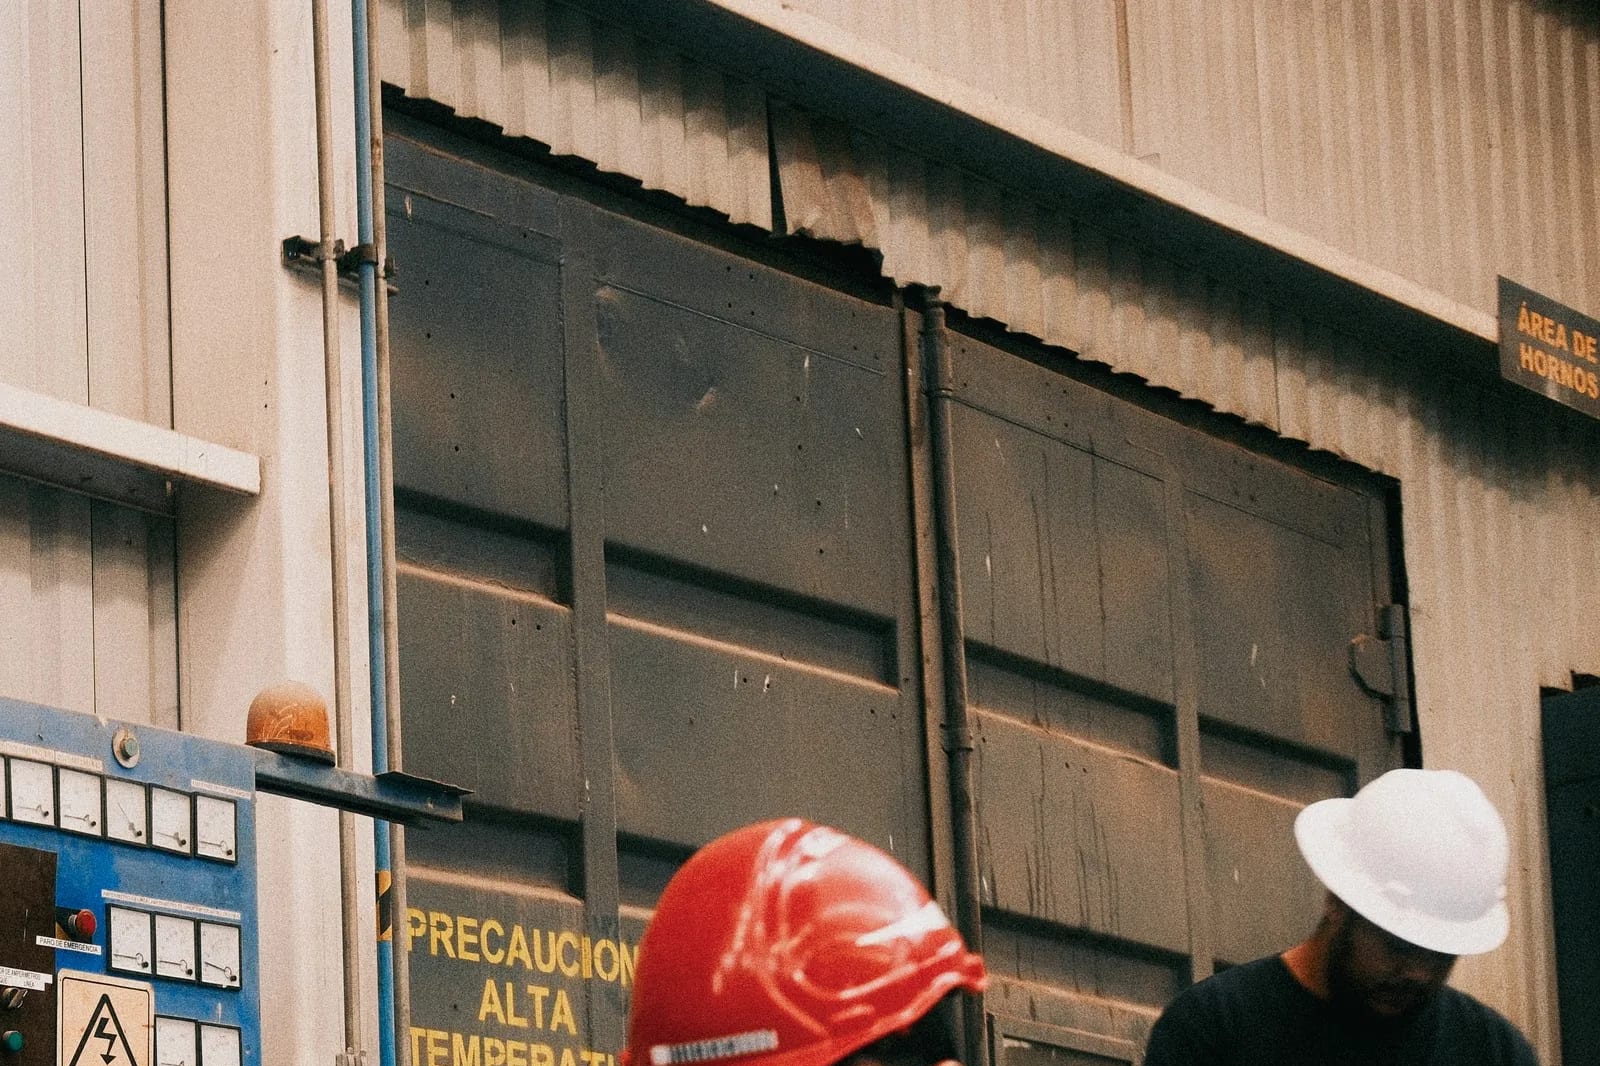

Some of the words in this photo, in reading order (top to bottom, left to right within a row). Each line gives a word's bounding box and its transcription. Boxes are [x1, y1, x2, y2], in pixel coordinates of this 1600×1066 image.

[1517, 301, 1569, 351] ÁREA
[1572, 330, 1598, 364] DE
[1519, 341, 1599, 400] HORNOS
[40, 937, 54, 946] PARO
[55, 939, 63, 947] DE
[64, 941, 98, 953] EMERGENCIA
[406, 907, 640, 986] PRECAUCION
[478, 979, 578, 1036] ALTA
